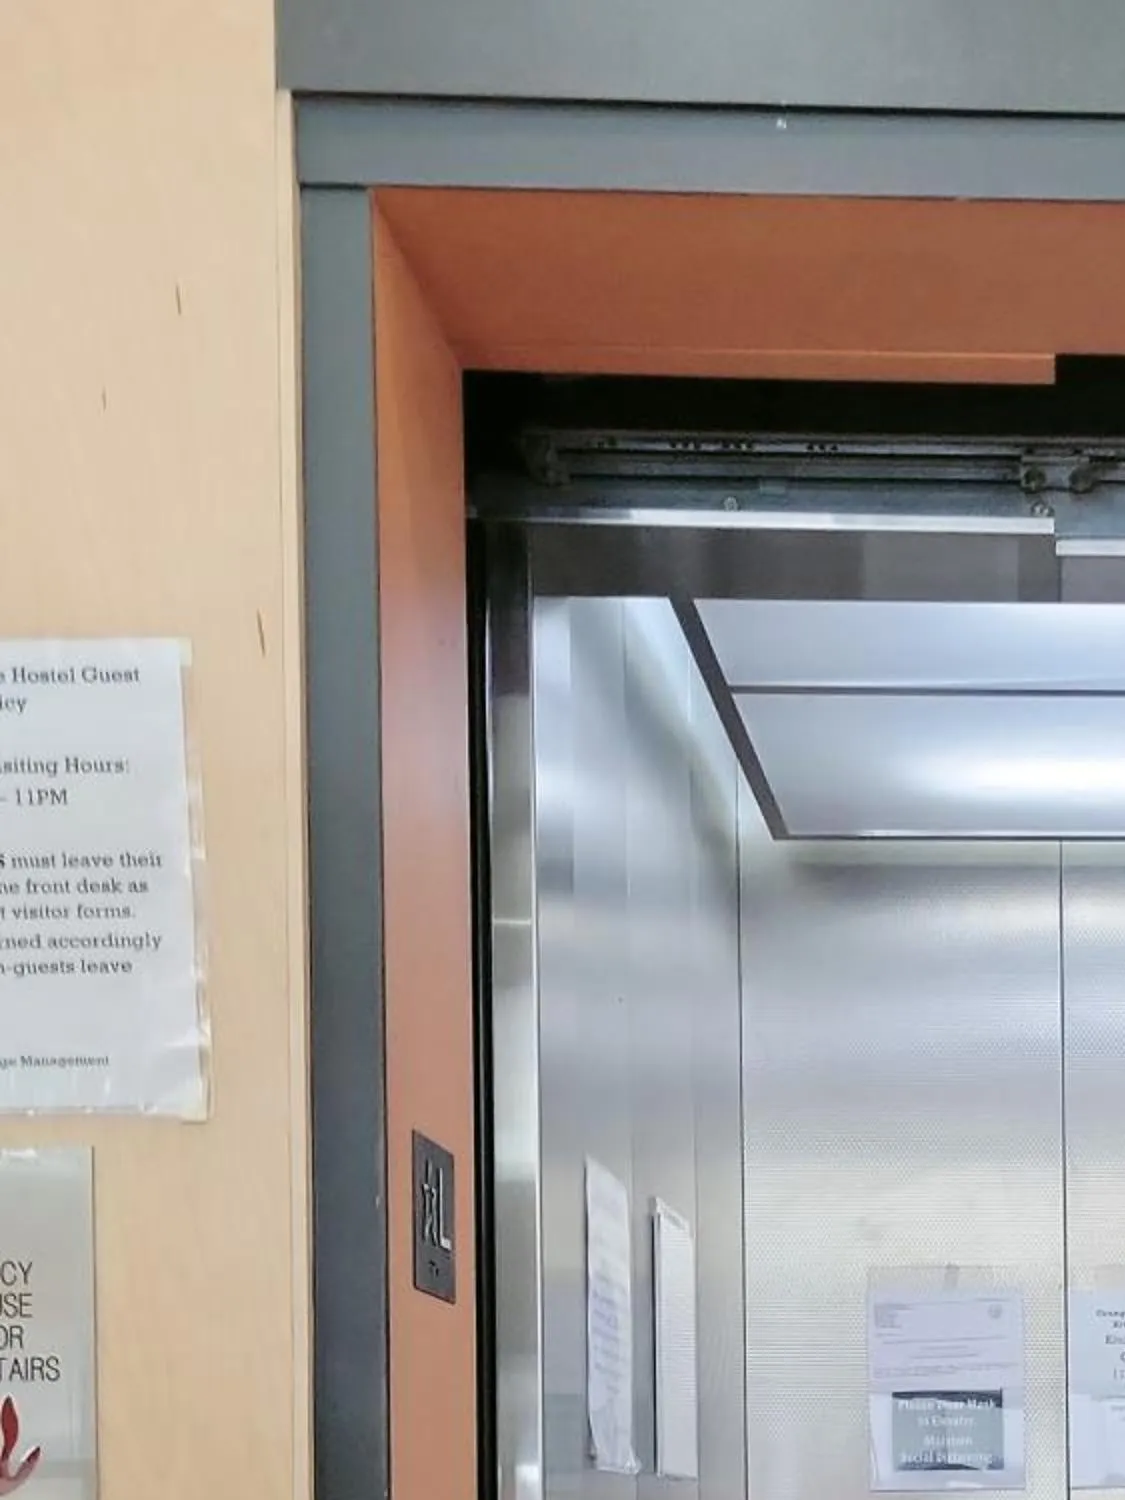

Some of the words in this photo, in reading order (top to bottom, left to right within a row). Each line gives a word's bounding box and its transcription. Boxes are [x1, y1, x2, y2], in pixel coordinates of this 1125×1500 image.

[12, 666, 76, 683] Hostel
[81, 666, 141, 683] Guest
[64, 755, 129, 774] Hours:
[15, 787, 68, 806] 11PM
[11, 854, 57, 869] must
[61, 851, 114, 868] leave
[118, 852, 163, 869] their
[25, 877, 71, 895] front
[76, 877, 123, 895] desk
[127, 880, 149, 894] as
[11, 902, 69, 920] visitor
[46, 930, 163, 952] accordingly
[80, 958, 134, 975] leave
[20, 1055, 110, 1069] Management
[0, 1260, 33, 1286] CY
